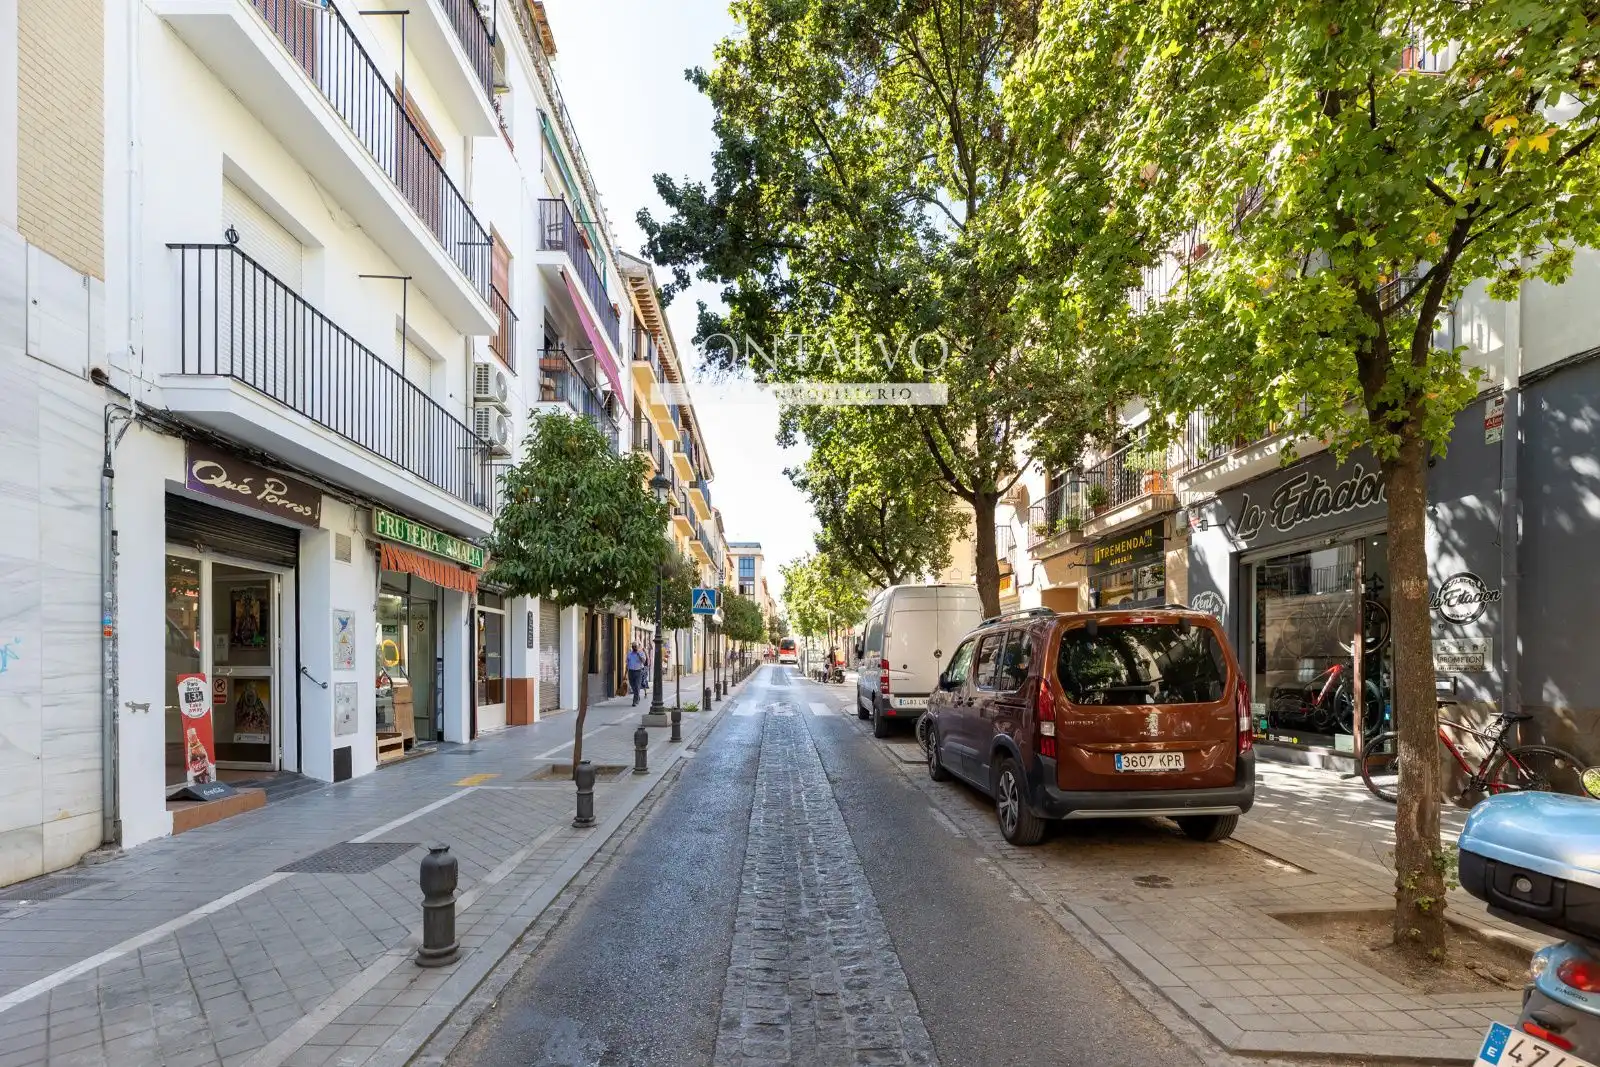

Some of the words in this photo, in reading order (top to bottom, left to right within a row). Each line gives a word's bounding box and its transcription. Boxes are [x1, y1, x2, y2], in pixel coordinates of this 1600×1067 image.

[191, 459, 253, 495] Qué
[1235, 492, 1266, 541] La
[377, 511, 440, 553] FRUTERIA
[445, 539, 481, 566] AMALIA
[1123, 755, 1154, 768] 3607
[1159, 755, 1183, 768] KPR
[1554, 987, 1589, 1002] PIAGGIO
[1486, 1045, 1498, 1058] E
[1507, 1038, 1586, 1067] 47
